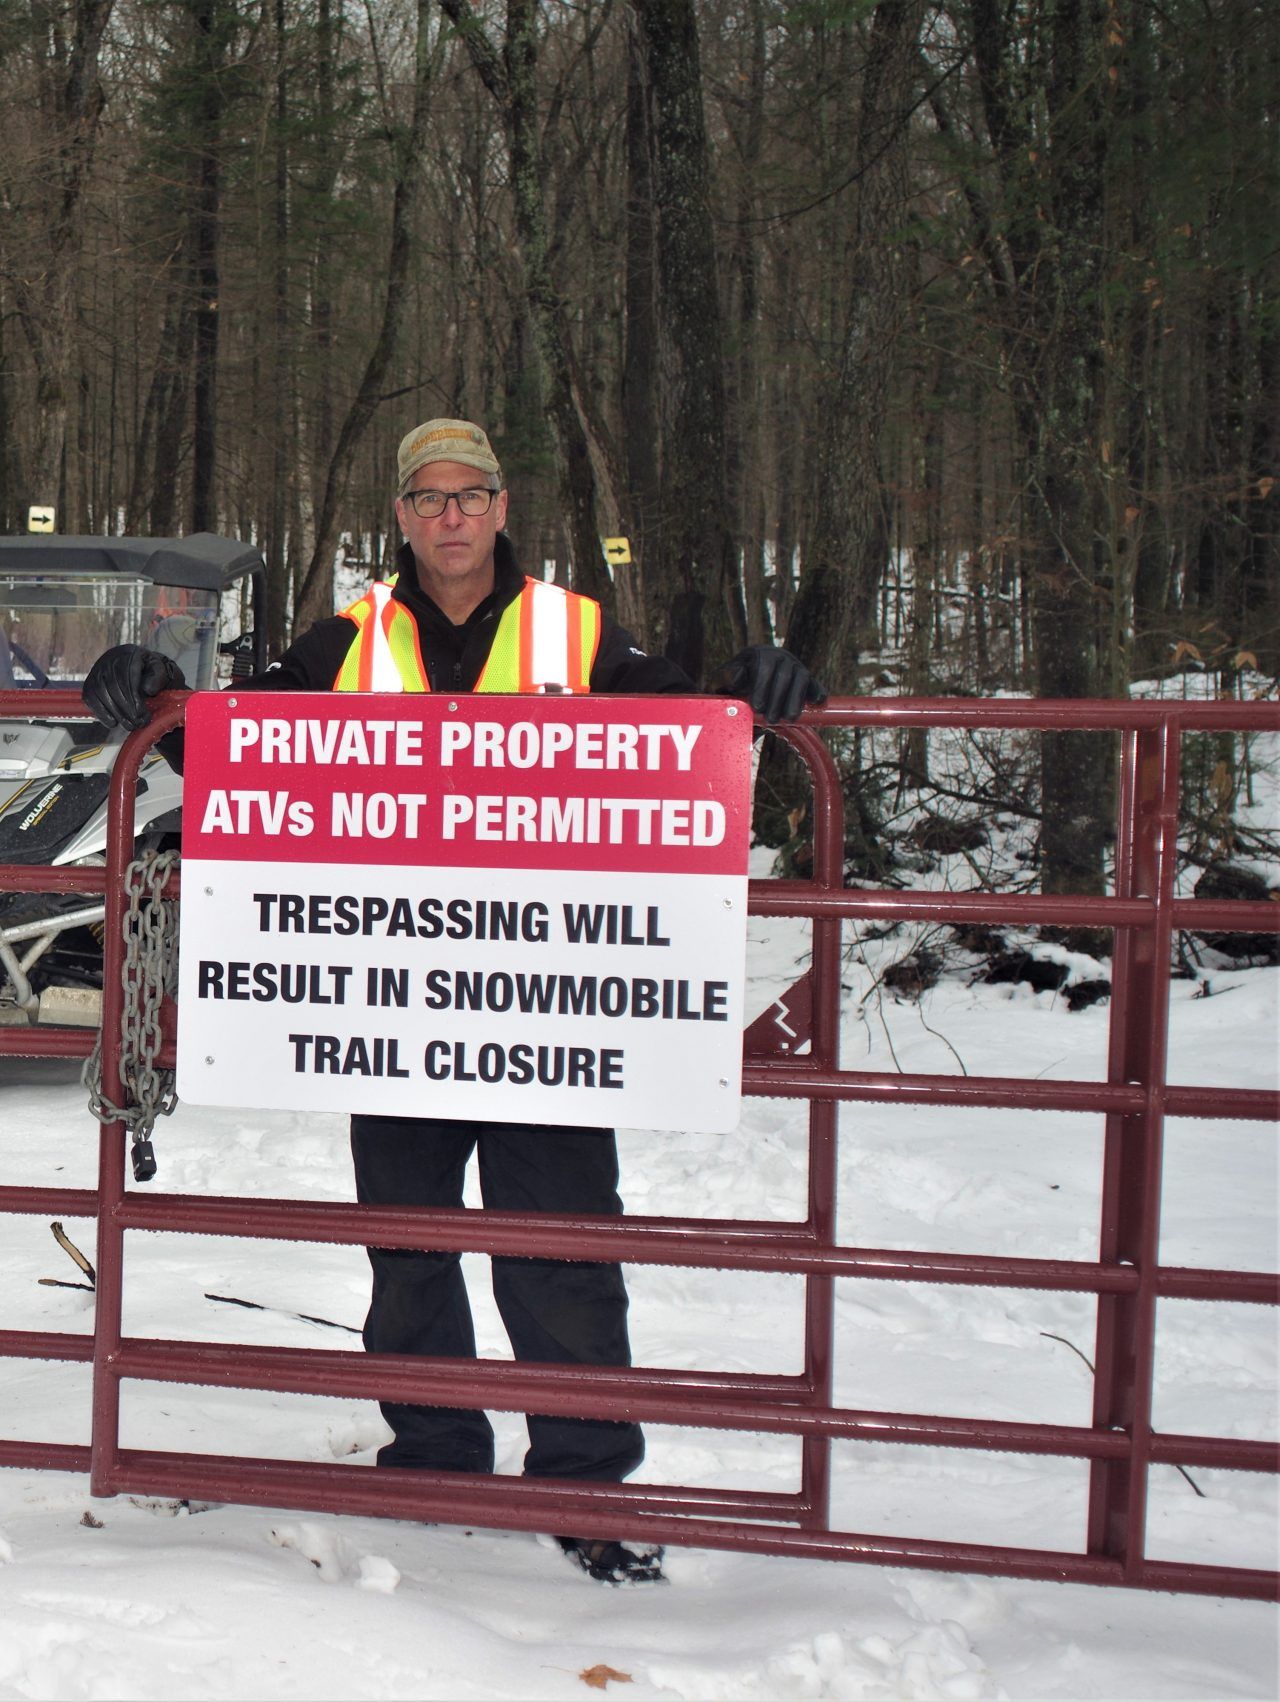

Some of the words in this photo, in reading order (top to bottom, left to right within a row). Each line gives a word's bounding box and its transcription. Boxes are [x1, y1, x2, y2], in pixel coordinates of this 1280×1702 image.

[230, 719, 422, 765] PRIVATE
[441, 722, 702, 770] PROPERTY
[19, 783, 63, 831] WOLVERINE
[201, 790, 314, 836] ATVs
[332, 793, 426, 838] NOT
[443, 795, 725, 846] PERMITTED
[254, 894, 548, 942] TRESPASSING
[563, 904, 670, 946] WILL
[199, 961, 352, 1004] RESULT
[367, 968, 408, 1007] IN
[425, 970, 727, 1021] SNOWMOBILE
[289, 1034, 409, 1077] TRAIL
[425, 1041, 623, 1088] CLOSURE
